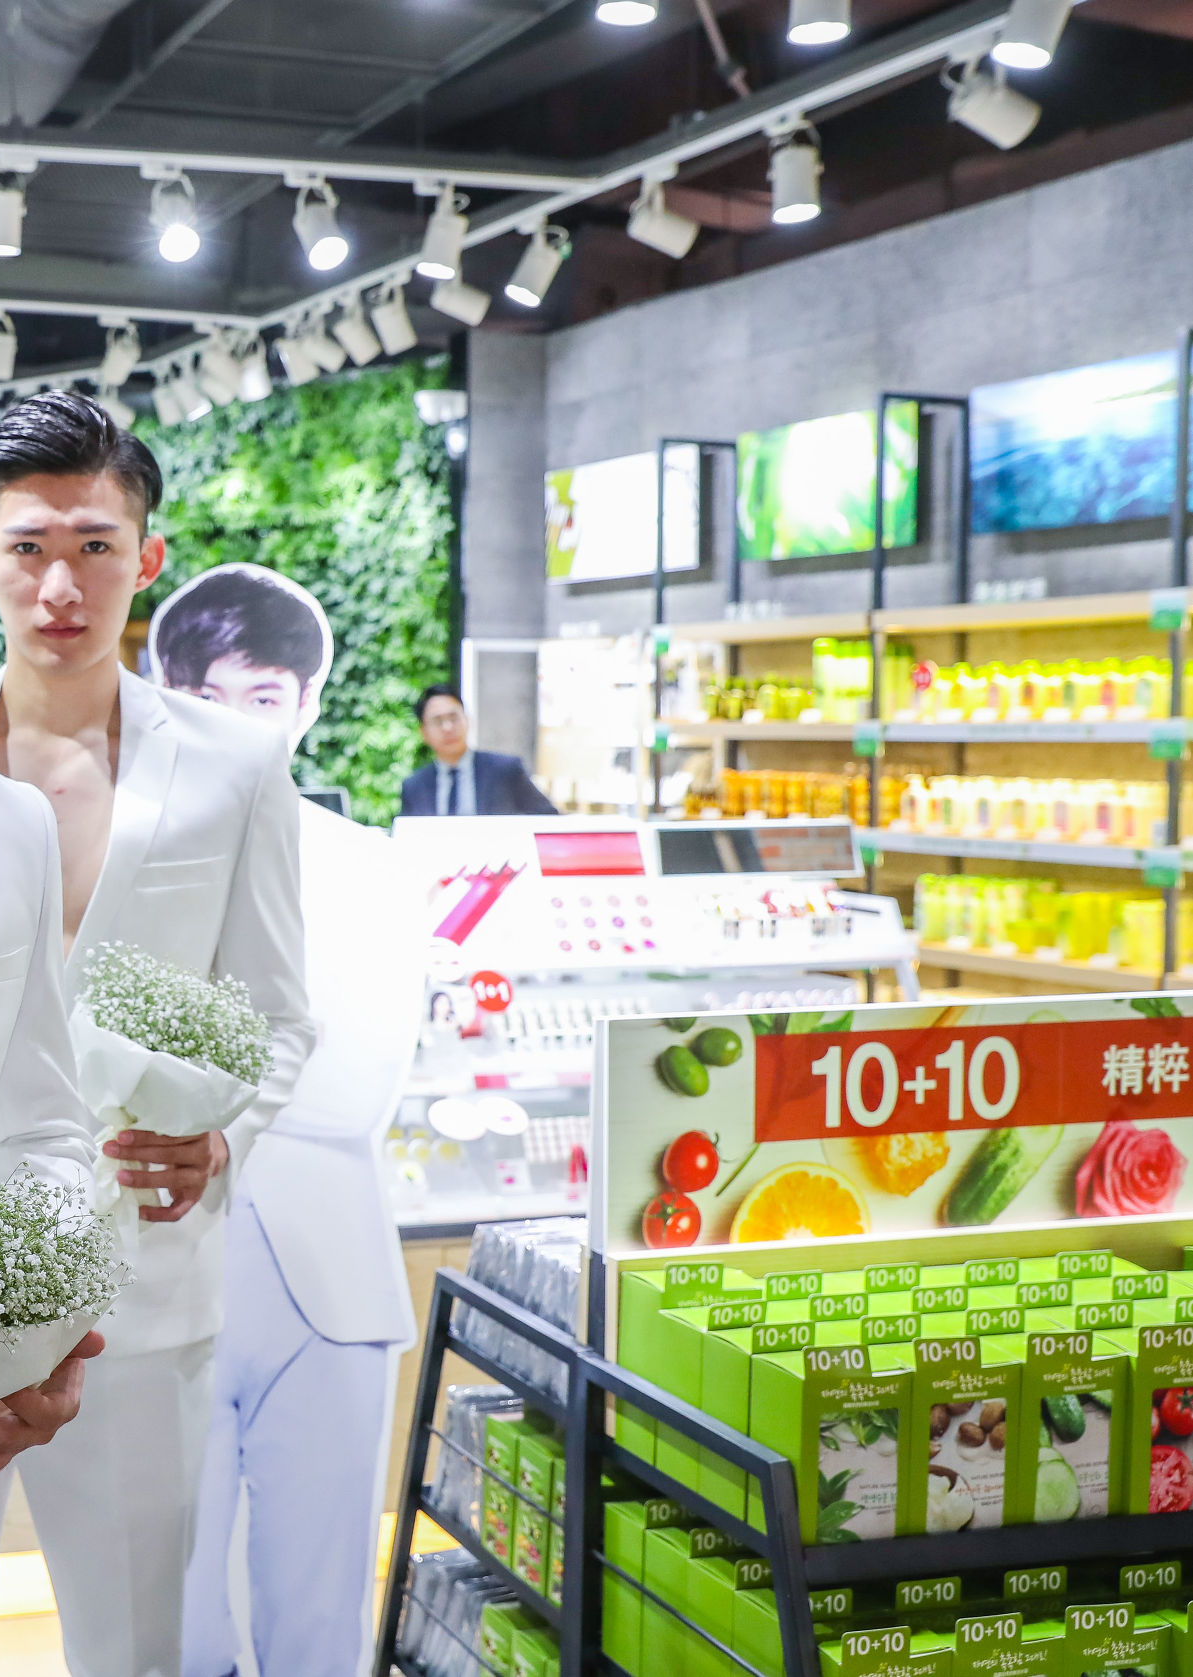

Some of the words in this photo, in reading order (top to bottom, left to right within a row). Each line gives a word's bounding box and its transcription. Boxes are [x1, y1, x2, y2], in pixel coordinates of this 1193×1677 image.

[812, 1036, 1020, 1128] 10+10
[1102, 1042, 1189, 1096] 精粹
[968, 1262, 1016, 1282] 10+10
[1061, 1255, 1108, 1273] 10+10
[668, 1266, 719, 1285] 10+10
[769, 1275, 819, 1295] 10+10
[868, 1267, 916, 1287] 10+10
[1116, 1276, 1163, 1295] 10+10
[915, 1288, 964, 1308] 10+10
[1020, 1284, 1068, 1304] 10+10
[712, 1304, 762, 1324] 10+10
[814, 1296, 864, 1317] 10+10
[1079, 1304, 1128, 1324] 10+10
[865, 1318, 916, 1338] 10+10
[970, 1310, 1020, 1331] 10+10
[756, 1325, 809, 1347] 10+10
[1032, 1336, 1087, 1356] 10+10
[1143, 1328, 1193, 1349] 10+10
[808, 1349, 864, 1371] 10+10
[918, 1340, 975, 1362] 10+10
[1009, 1572, 1060, 1593] 10+10
[1125, 1567, 1175, 1588] 10+10
[901, 1582, 954, 1605] 10+10
[1071, 1609, 1128, 1630] 10+10
[961, 1619, 1016, 1642] 10+10
[847, 1632, 904, 1656] 10+10
